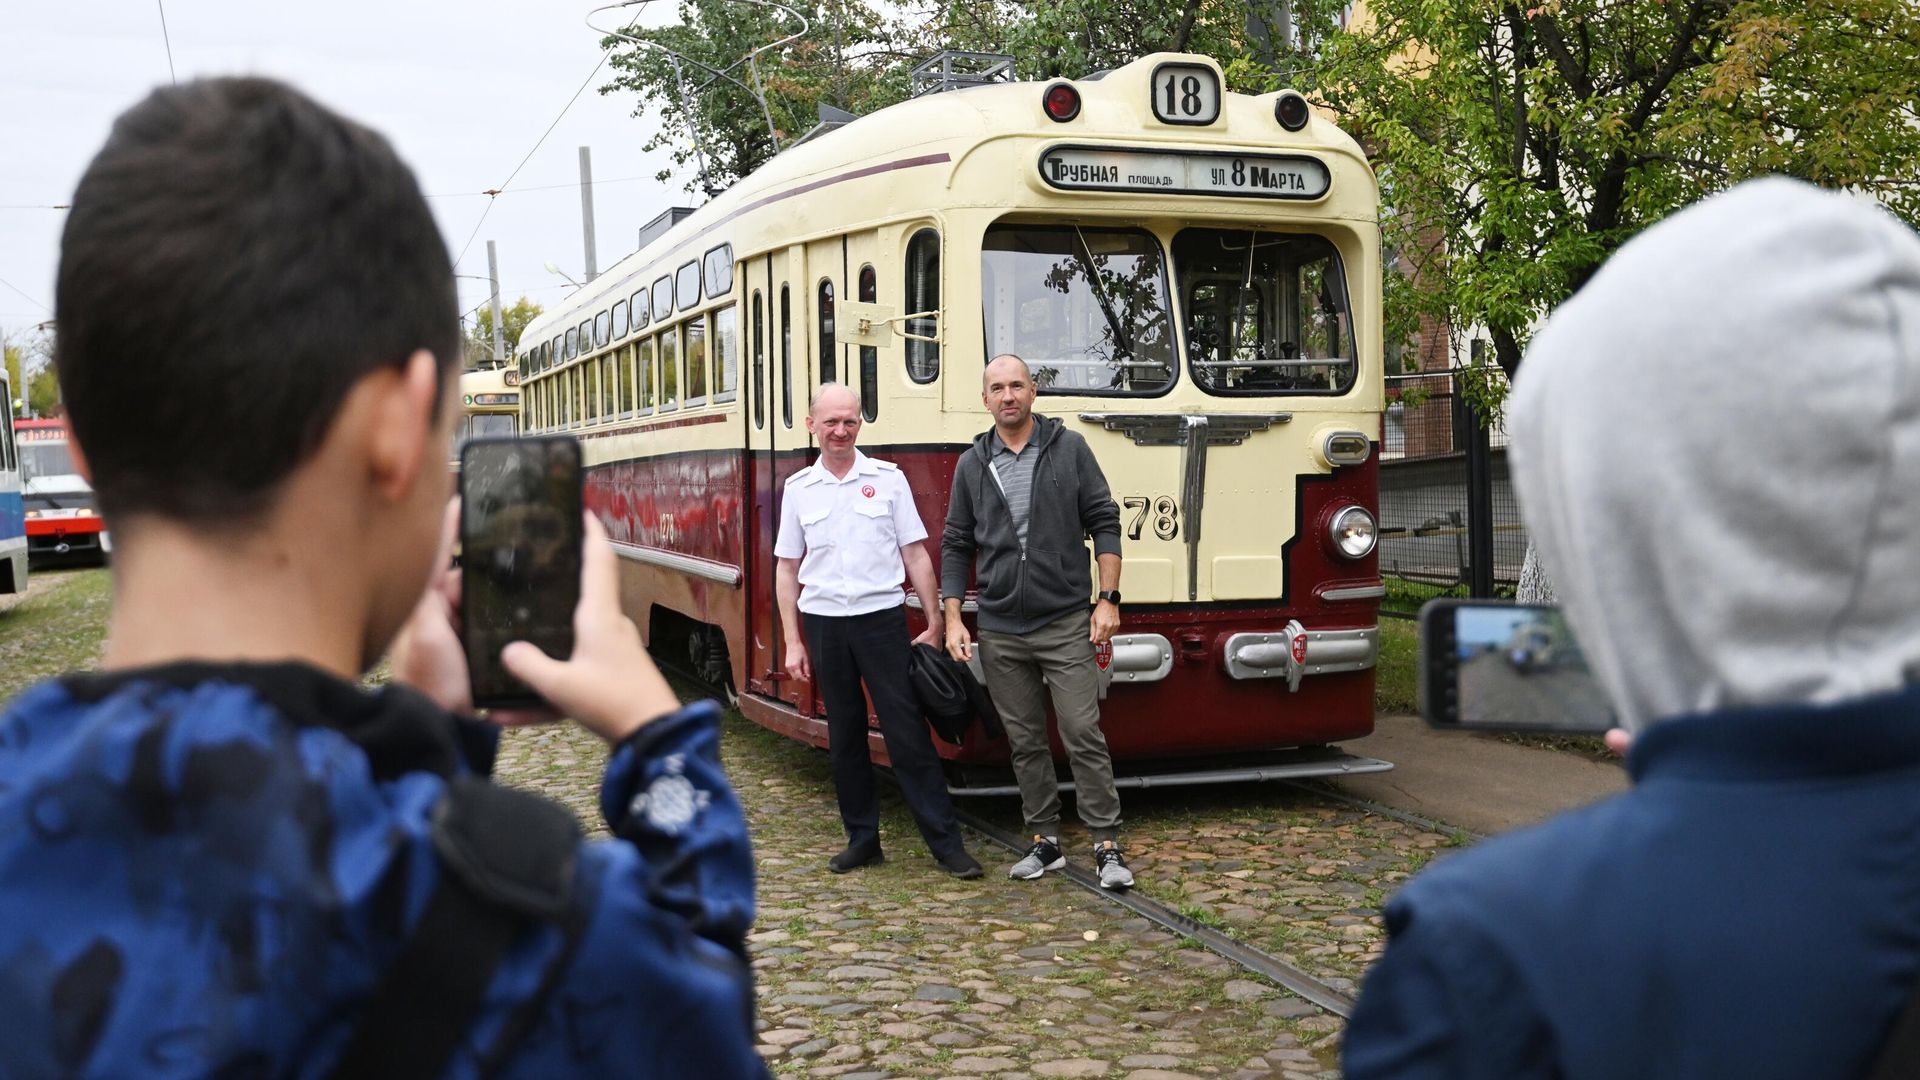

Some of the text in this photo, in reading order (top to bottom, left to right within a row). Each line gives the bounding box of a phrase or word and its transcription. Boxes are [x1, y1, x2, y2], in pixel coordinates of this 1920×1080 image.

[1164, 75, 1202, 116] 18
[1047, 157, 1174, 186] ТРУБНАЯ ПЛОЩАДЬ
[1231, 159, 1246, 187] 8
[1250, 166, 1306, 190] МАРТА
